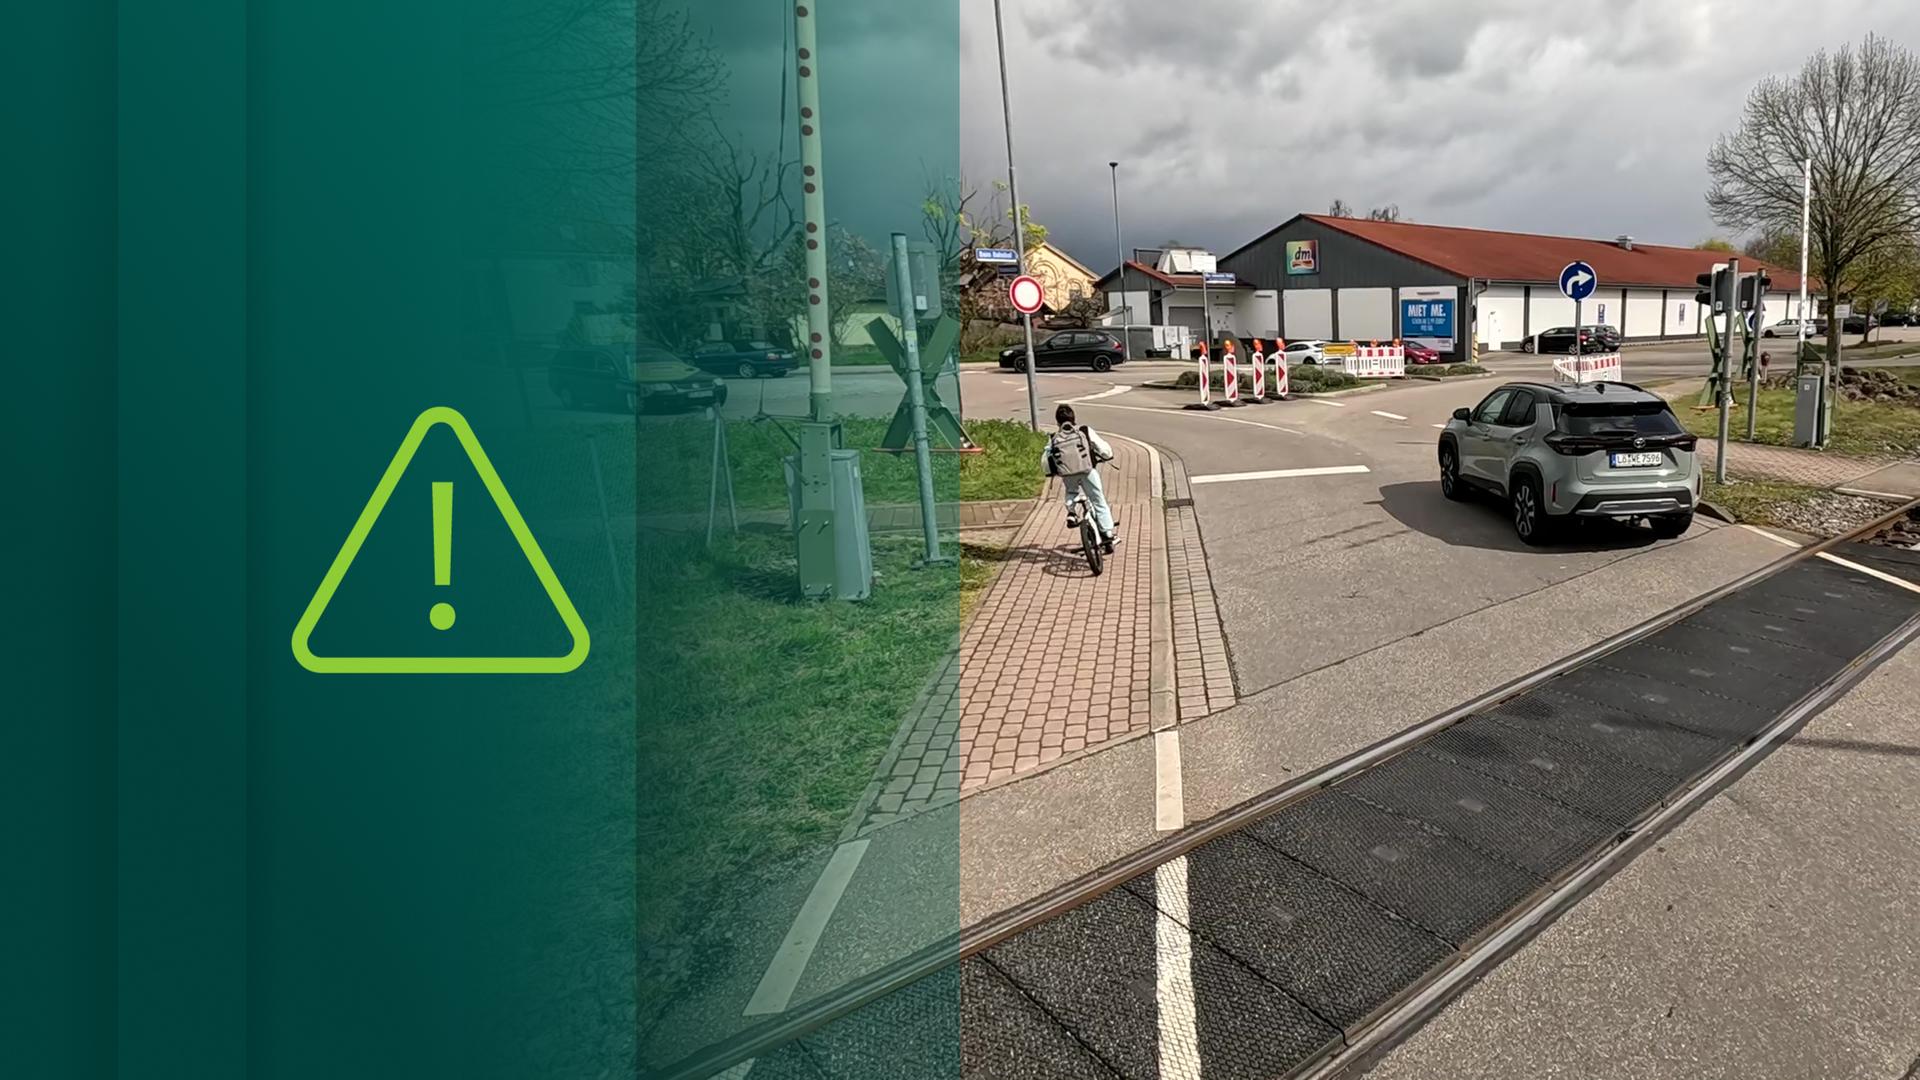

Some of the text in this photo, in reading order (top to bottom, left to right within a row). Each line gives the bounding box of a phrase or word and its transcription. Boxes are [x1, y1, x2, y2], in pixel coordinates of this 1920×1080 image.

[1295, 246, 1310, 260] dm
[1408, 304, 1446, 317] MIET ME.
[1642, 453, 1660, 463] 7596
